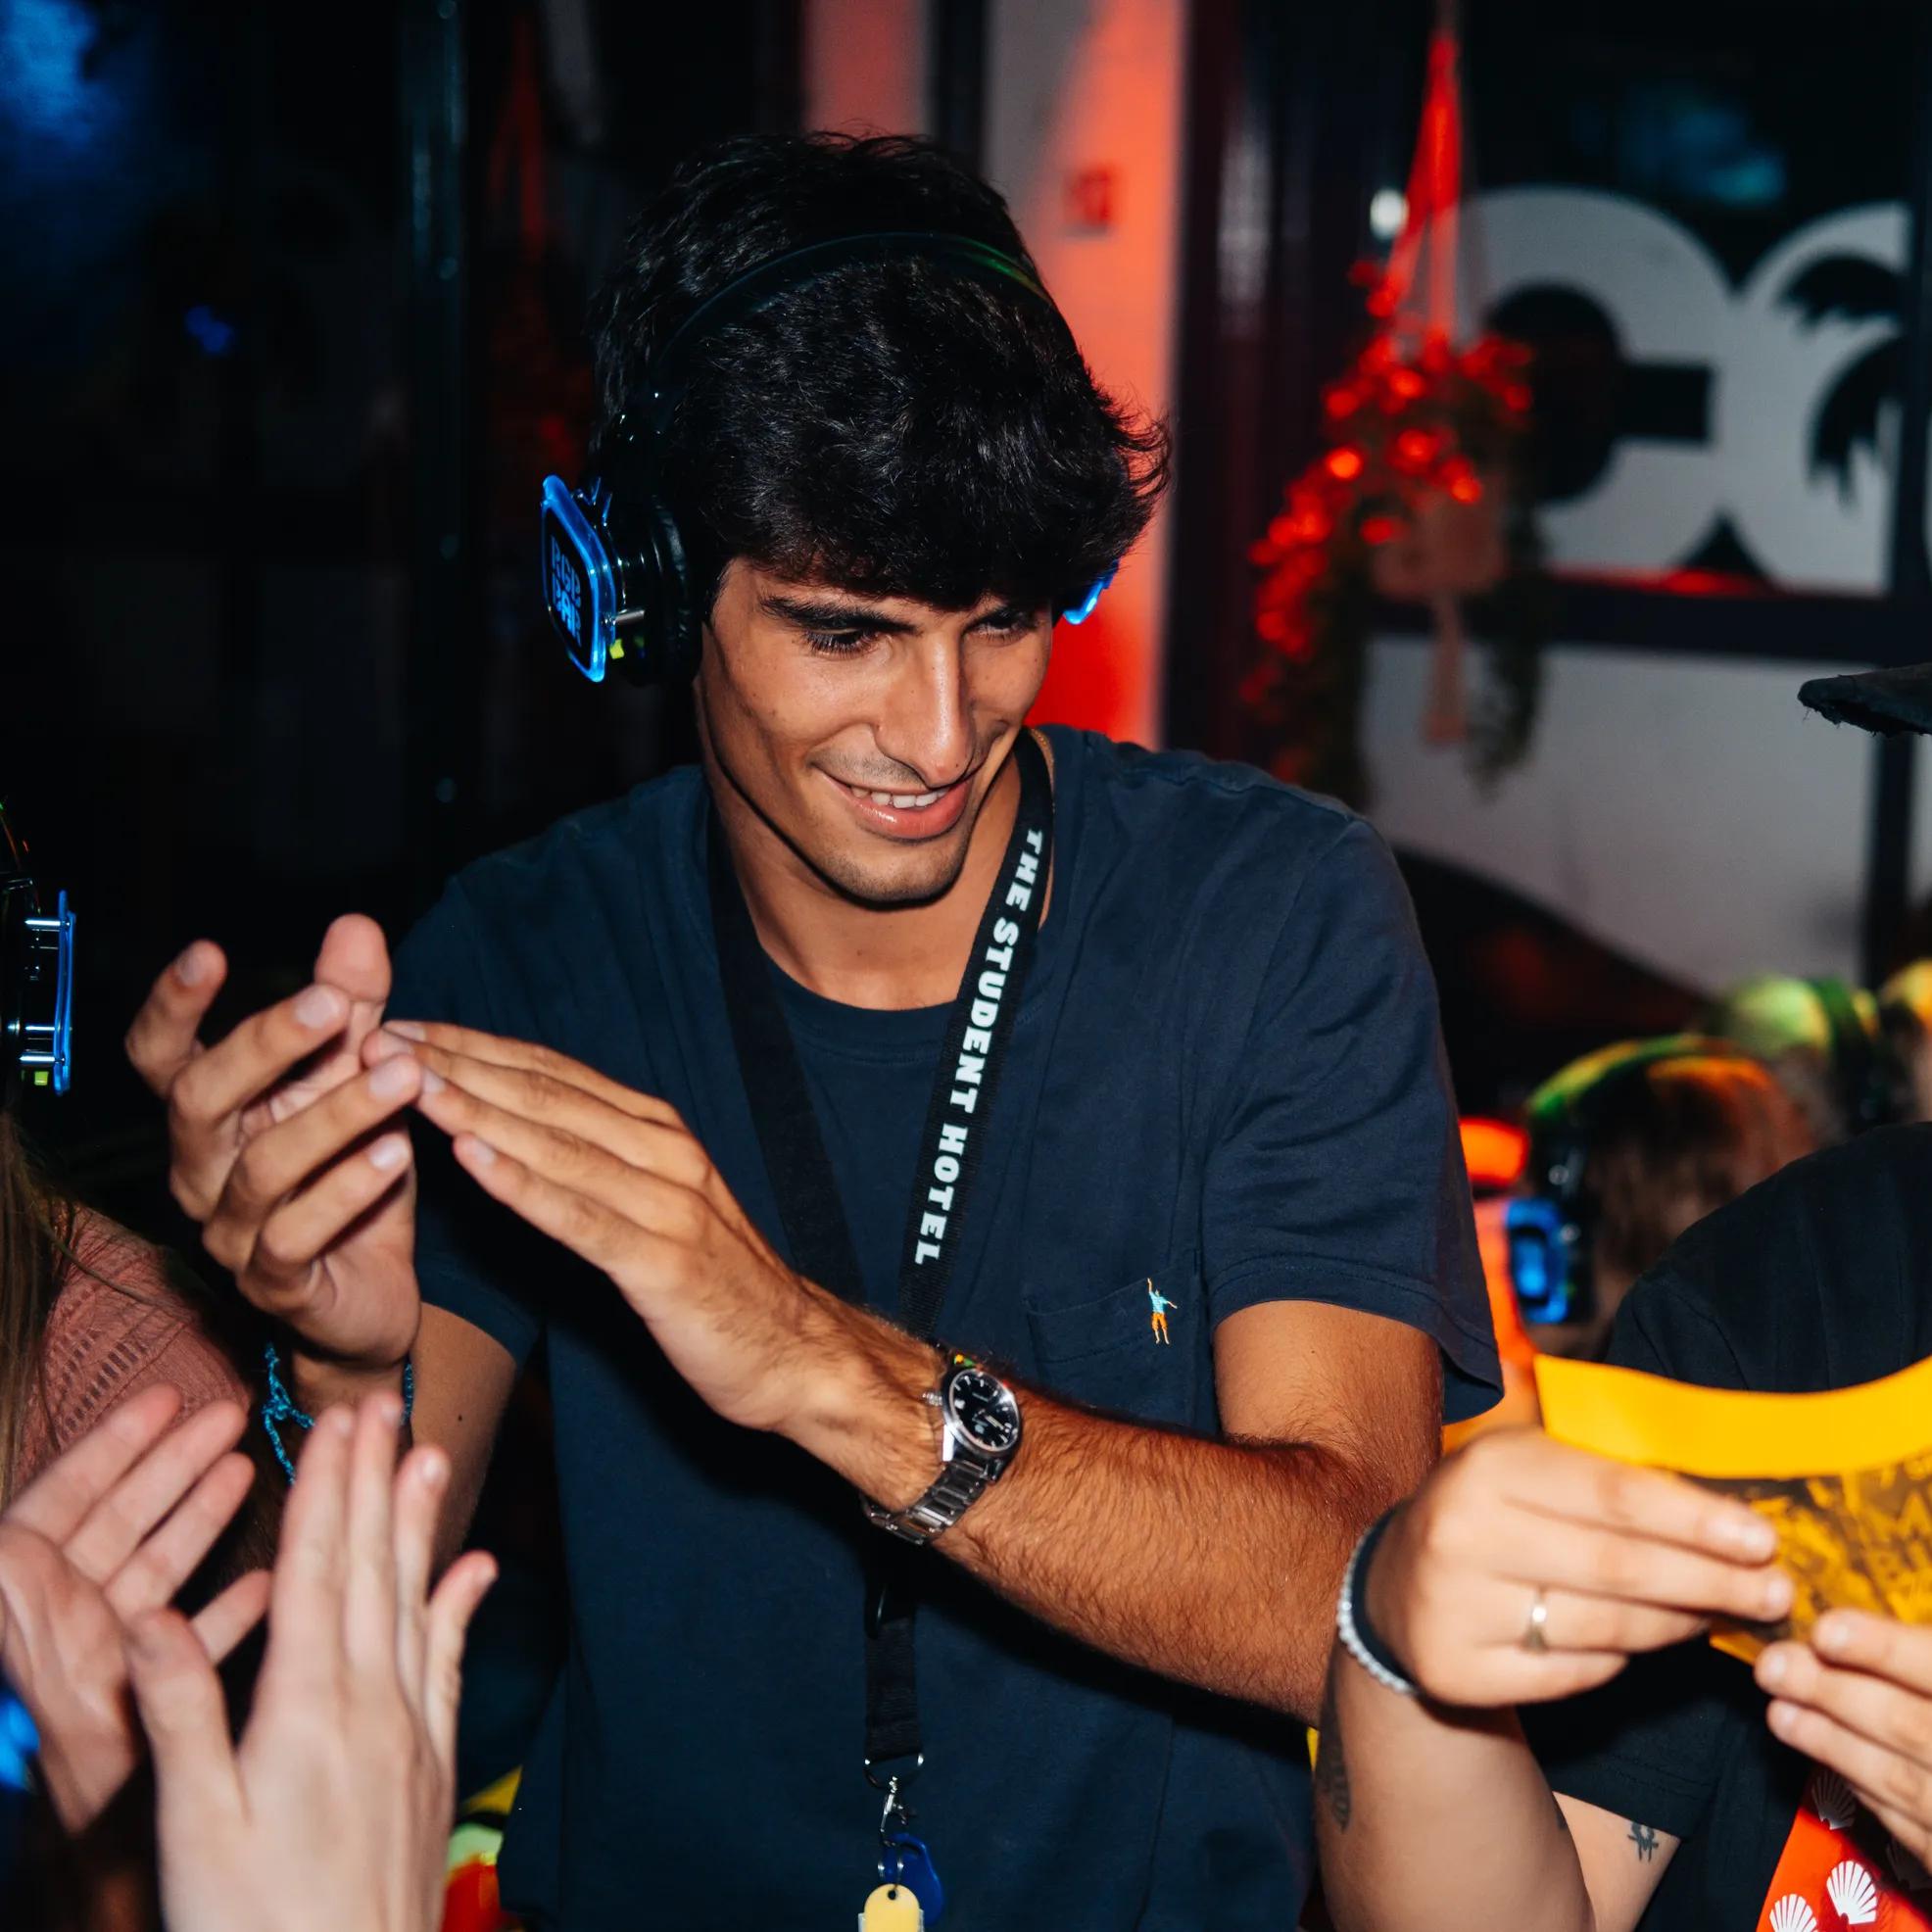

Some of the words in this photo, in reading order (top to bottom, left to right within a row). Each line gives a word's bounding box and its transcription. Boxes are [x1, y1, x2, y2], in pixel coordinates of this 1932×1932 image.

[1005, 829, 1046, 912] THE
[949, 917, 1020, 1114] STUDENT
[914, 1123, 968, 1265] HOTEL
